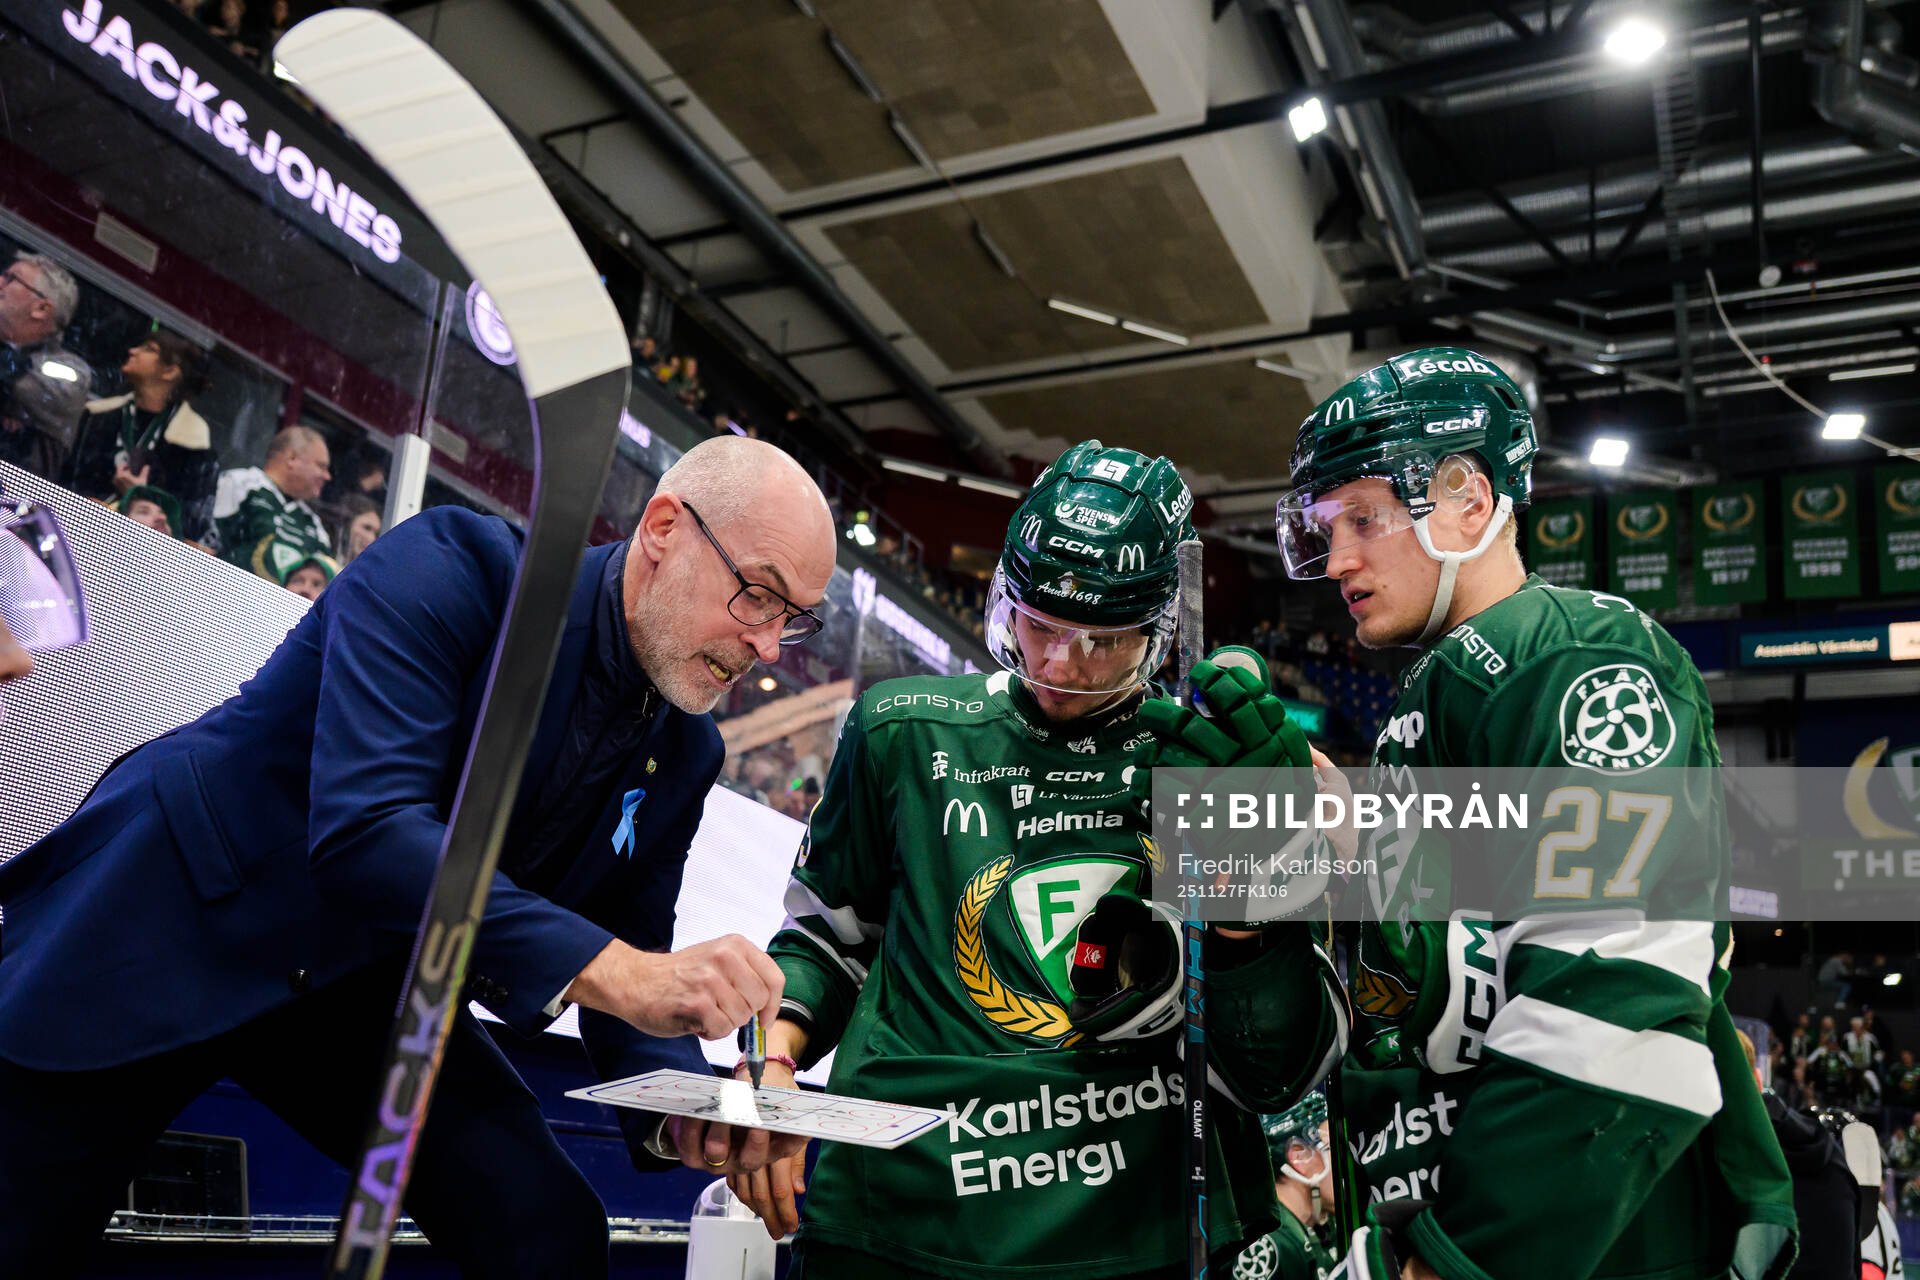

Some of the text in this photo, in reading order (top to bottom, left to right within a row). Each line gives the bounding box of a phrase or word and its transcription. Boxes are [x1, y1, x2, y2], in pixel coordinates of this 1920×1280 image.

[1426, 416, 1482, 433] CCM
[1158, 477, 1193, 525] Lecab
[1409, 505, 1434, 515] CCM
[1075, 515, 1097, 528] SPEL
[1048, 535, 1105, 559] CCM
[1069, 590, 1102, 605] 1698
[1576, 669, 1662, 712] FLÄKT
[1565, 734, 1663, 768] TEKNIK
[954, 765, 1031, 784] Infrakraft
[1045, 771, 1106, 782] CCM
[1038, 790, 1059, 799] LF
[1017, 810, 1124, 840] Helmia
[1533, 785, 1673, 899] 27
[1456, 916, 1498, 1066] CCM
[333, 919, 477, 1275] TACKS
[945, 1065, 1187, 1143] Karlstads
[951, 1140, 1126, 1196] Energi
